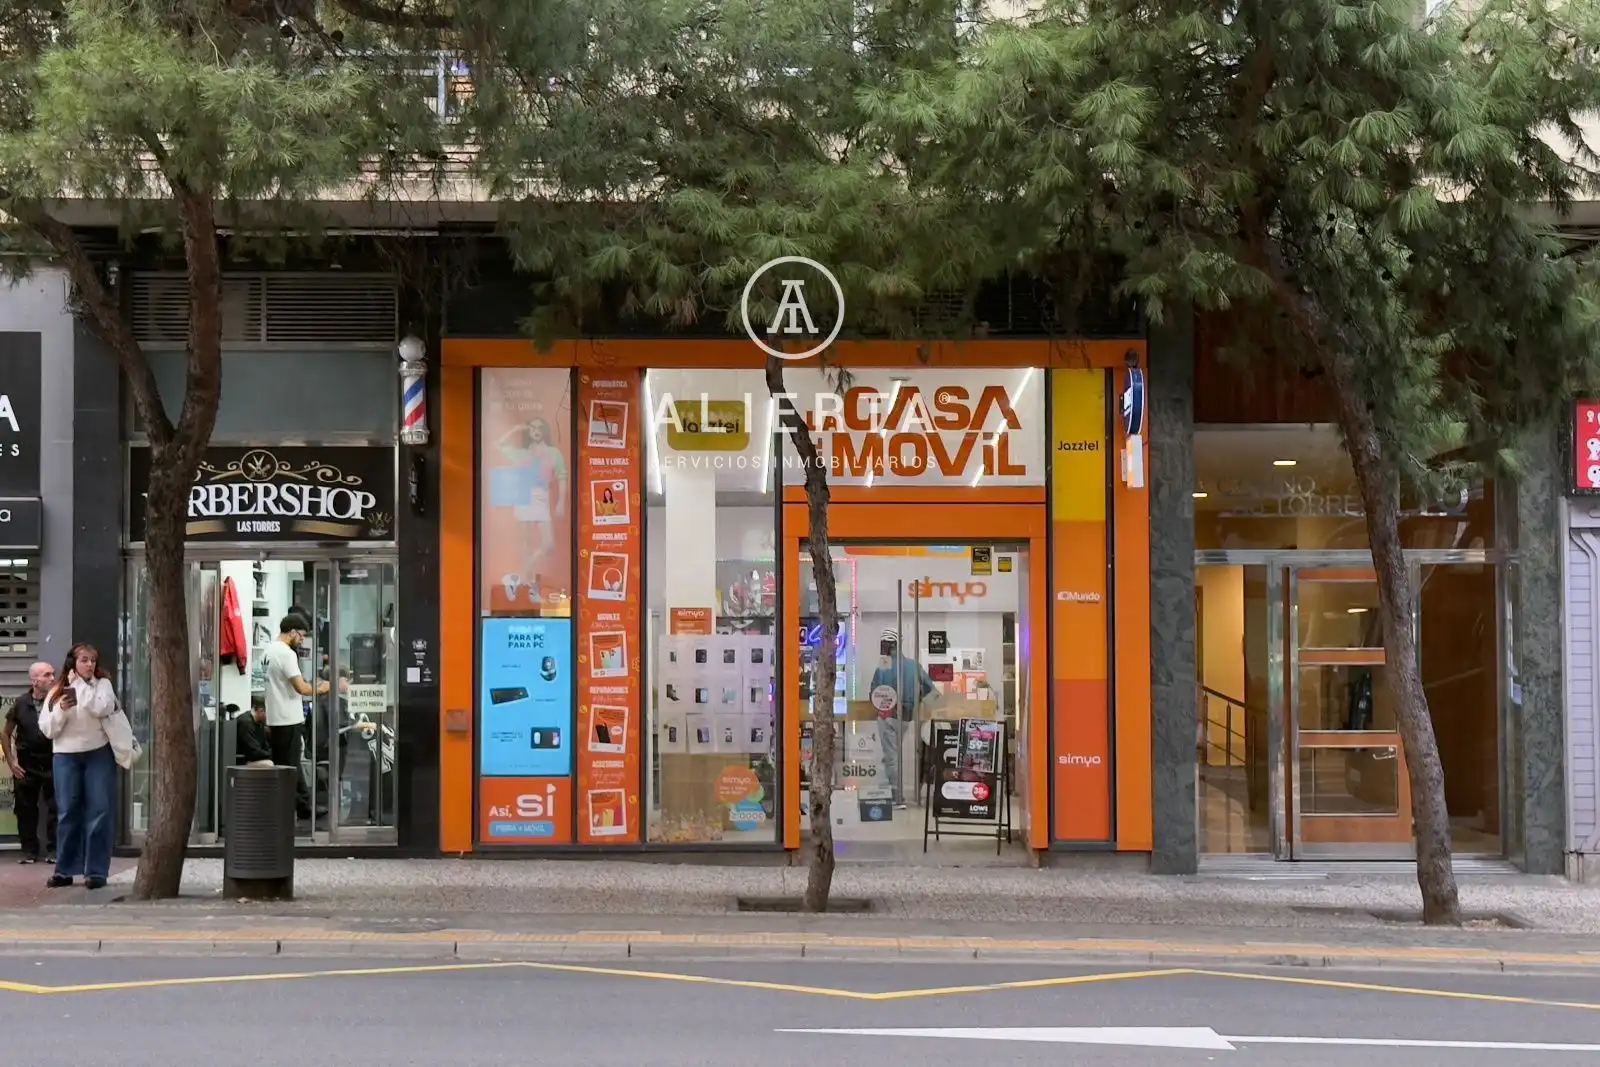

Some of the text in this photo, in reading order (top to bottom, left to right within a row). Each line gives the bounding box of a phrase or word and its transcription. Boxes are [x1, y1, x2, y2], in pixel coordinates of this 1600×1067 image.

[844, 386, 1022, 431] CASA
[1057, 440, 1099, 451] Jazztel
[141, 483, 377, 520] RBERSHOP
[237, 521, 281, 533] LAS TORRES
[508, 633, 545, 641] PARA PC
[508, 641, 545, 649] PARA PC
[1058, 753, 1101, 767] simyo
[842, 765, 877, 777] Silbö
